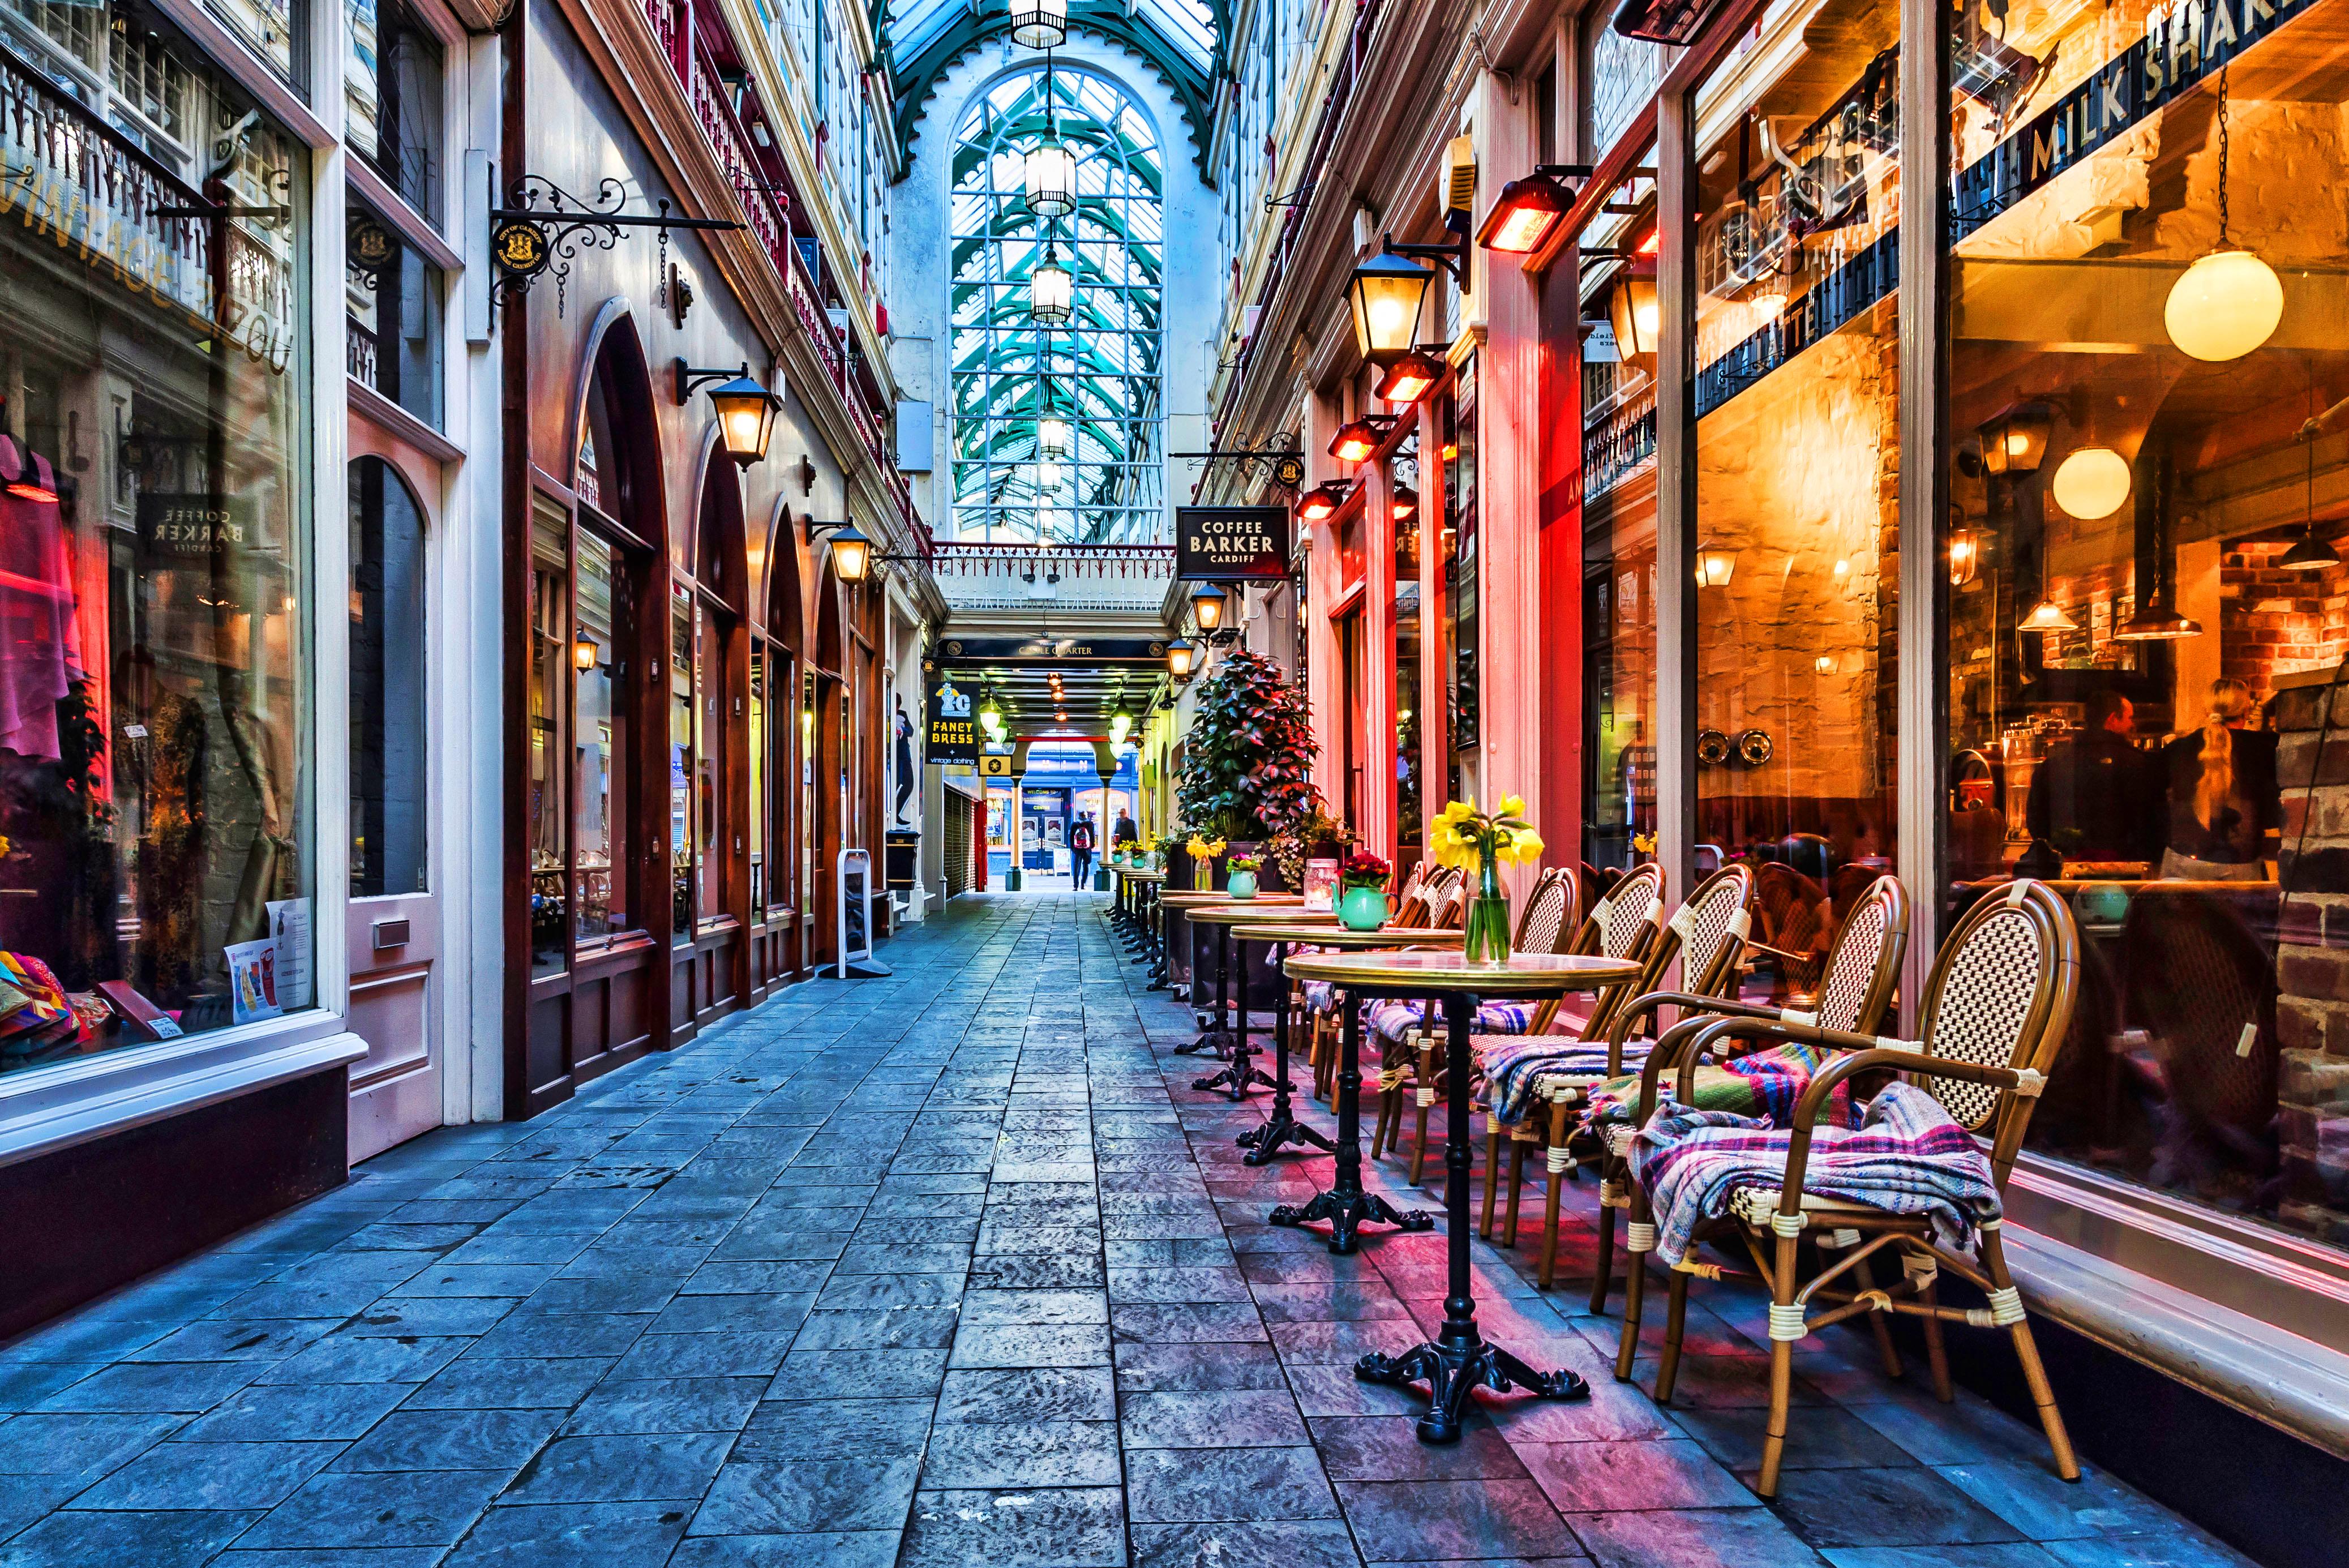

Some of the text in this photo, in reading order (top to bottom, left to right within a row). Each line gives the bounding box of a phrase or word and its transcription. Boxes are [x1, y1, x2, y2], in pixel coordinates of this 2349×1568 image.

[2030, 0, 2296, 182] MILK SHAK
[0, 148, 175, 309] VINTAGE
[1202, 522, 1262, 533] COFFEE
[1190, 536, 1274, 552] BARKER
[1210, 555, 1255, 563] CARDIFF
[933, 722, 973, 732] FANCY
[932, 733, 974, 744] DRESS
